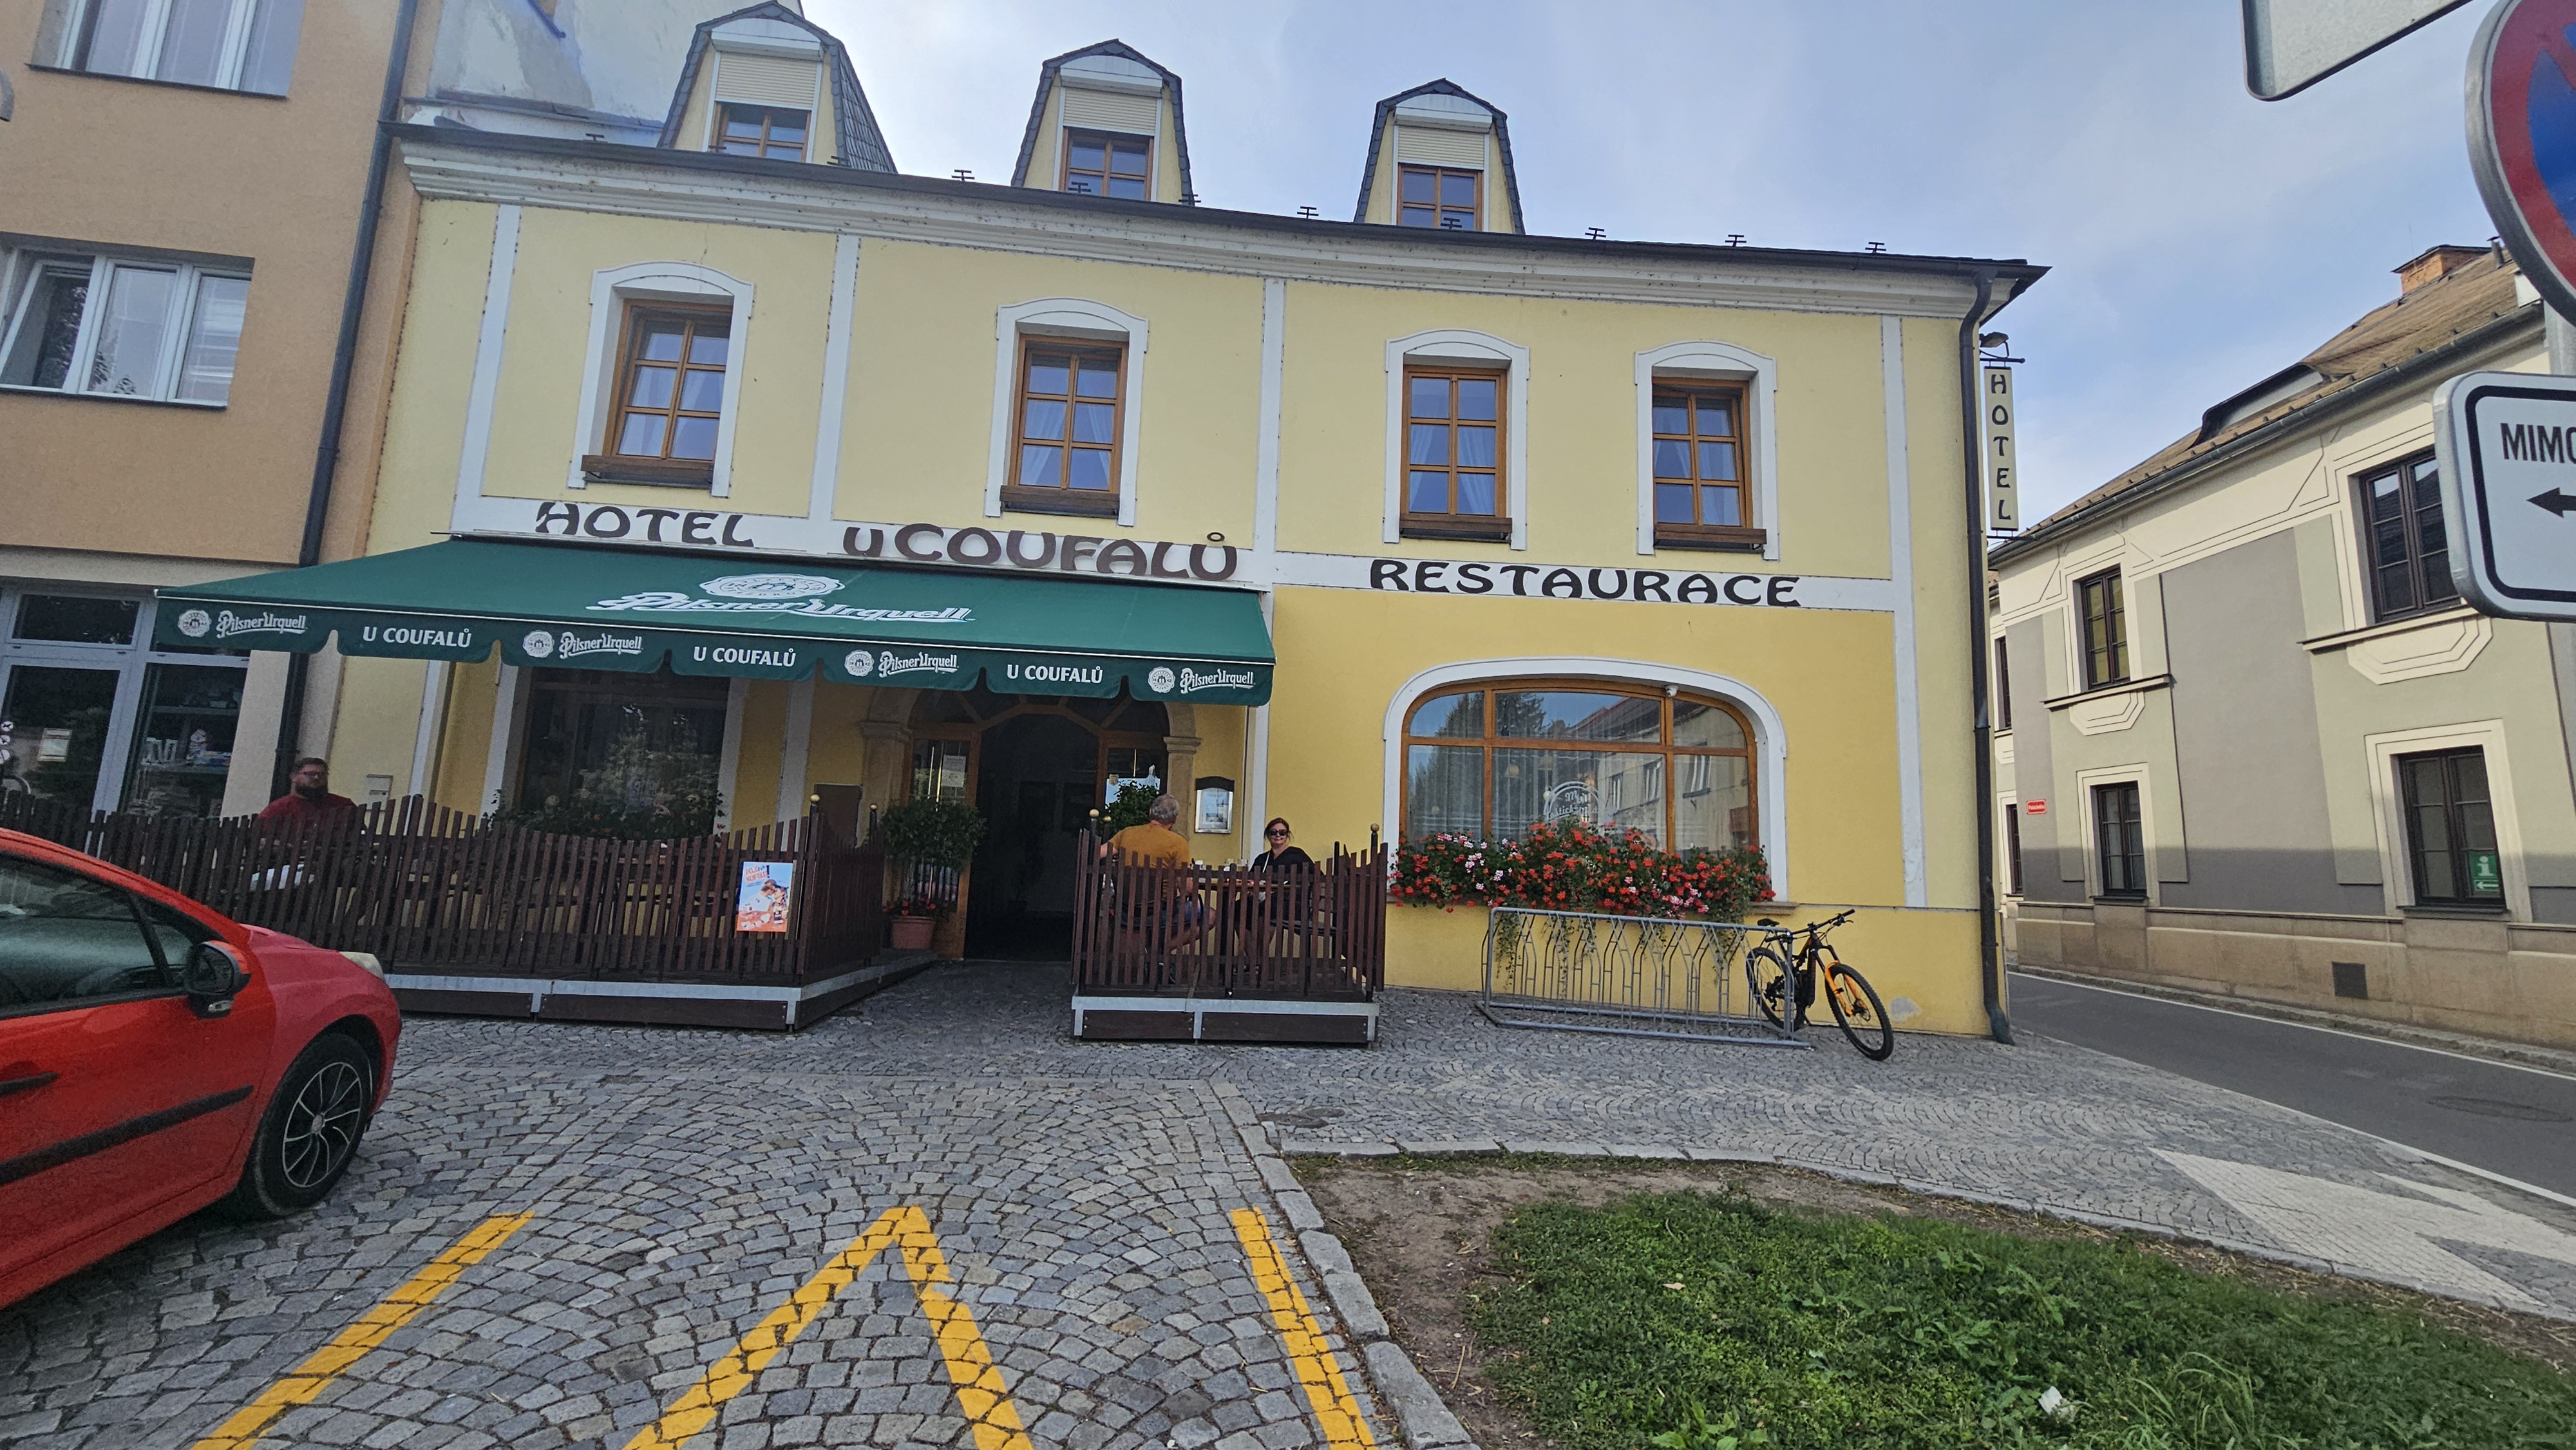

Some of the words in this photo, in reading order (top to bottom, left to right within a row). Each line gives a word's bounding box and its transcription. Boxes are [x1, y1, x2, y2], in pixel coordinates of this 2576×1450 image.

[1991, 374, 2011, 520] HOTEL
[535, 502, 754, 547] HOTEL
[895, 523, 1238, 581] COUFALŮ
[1370, 559, 1801, 607] RESTAURACE
[586, 592, 799, 612] Pilsner
[797, 598, 972, 622] Urquell
[216, 610, 265, 639] Pilsner
[263, 612, 306, 634] Urquell
[363, 626, 377, 642] U
[383, 626, 472, 648] COUFALŮ
[559, 632, 602, 659] Pilsner
[601, 633, 642, 655] Urquell
[693, 646, 706, 663] U
[712, 646, 796, 668] COUFALŮ
[878, 651, 920, 678] Pilsner
[918, 652, 957, 673] Urquell
[1007, 664, 1019, 680] U
[1022, 664, 1103, 684] COUFALŮ
[1179, 668, 1218, 694] Pilsner
[1217, 668, 1254, 690] Urquell
